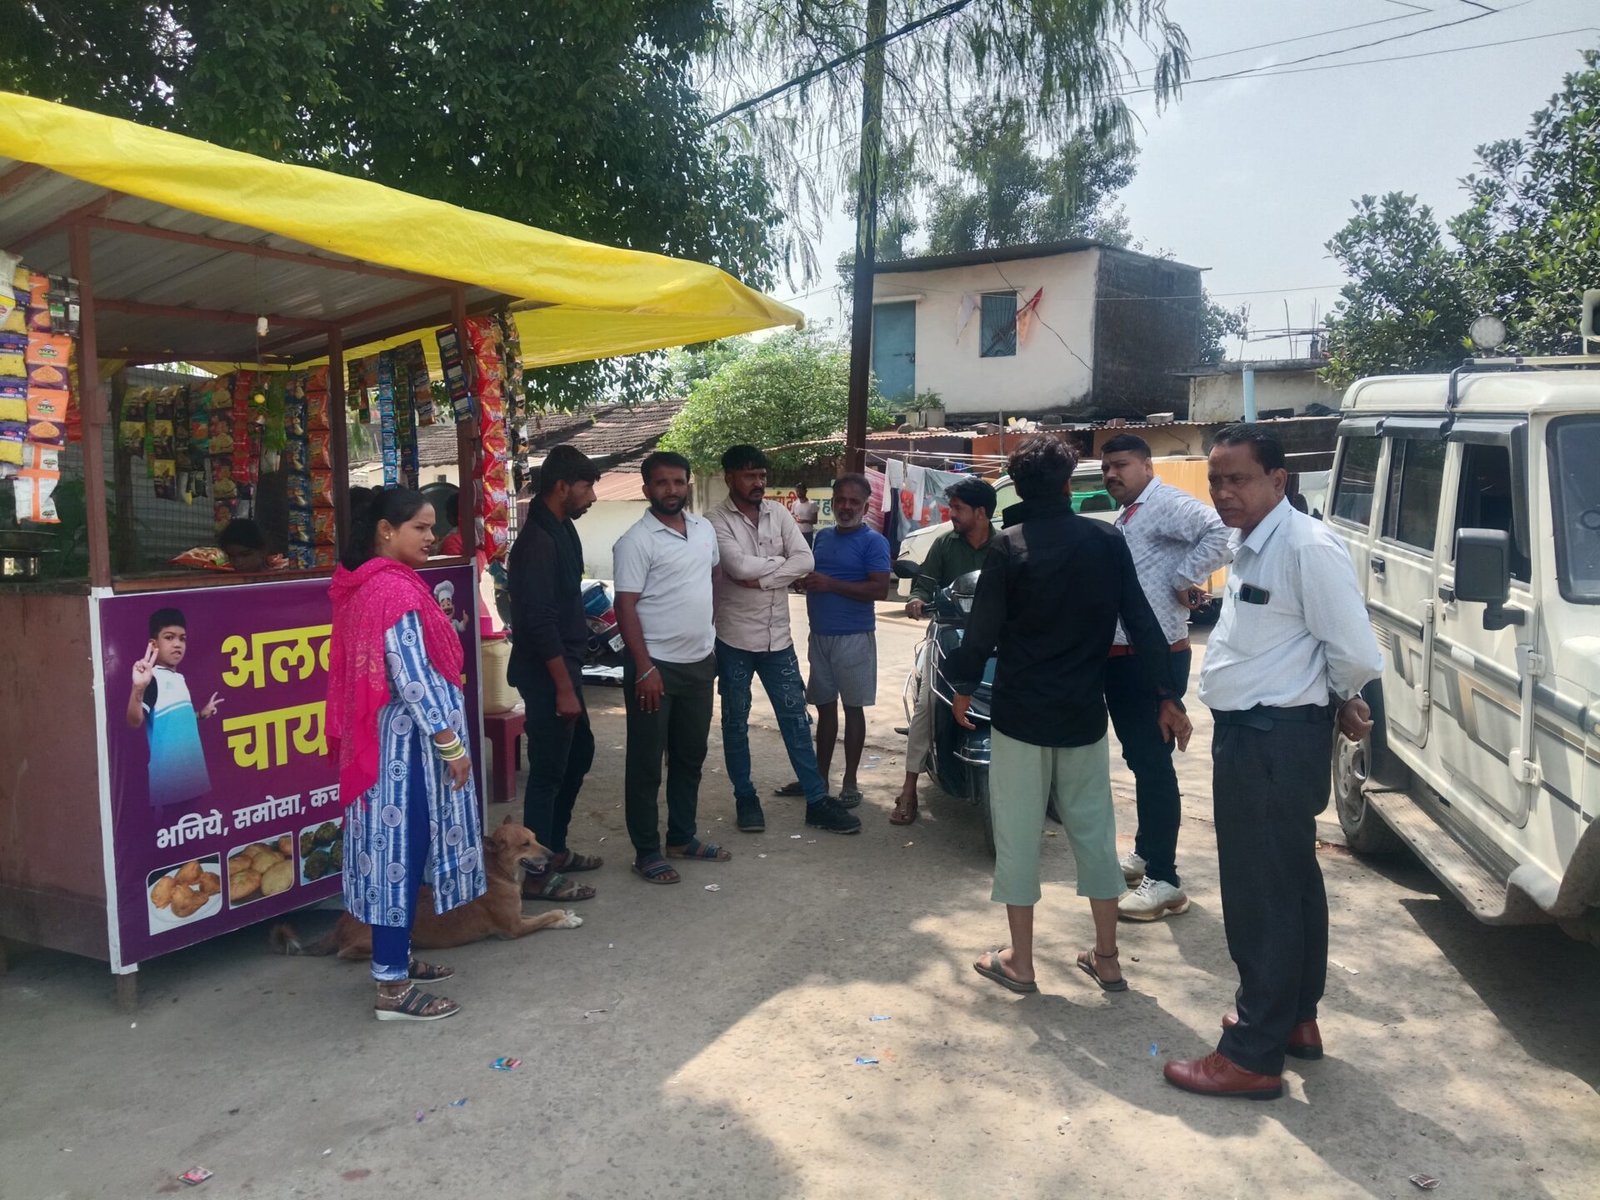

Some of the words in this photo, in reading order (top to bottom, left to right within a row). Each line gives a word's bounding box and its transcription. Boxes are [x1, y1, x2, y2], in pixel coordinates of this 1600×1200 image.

[156, 809, 229, 849] भजिये,
[232, 795, 306, 830] समोसा,
[309, 783, 341, 808] कच
